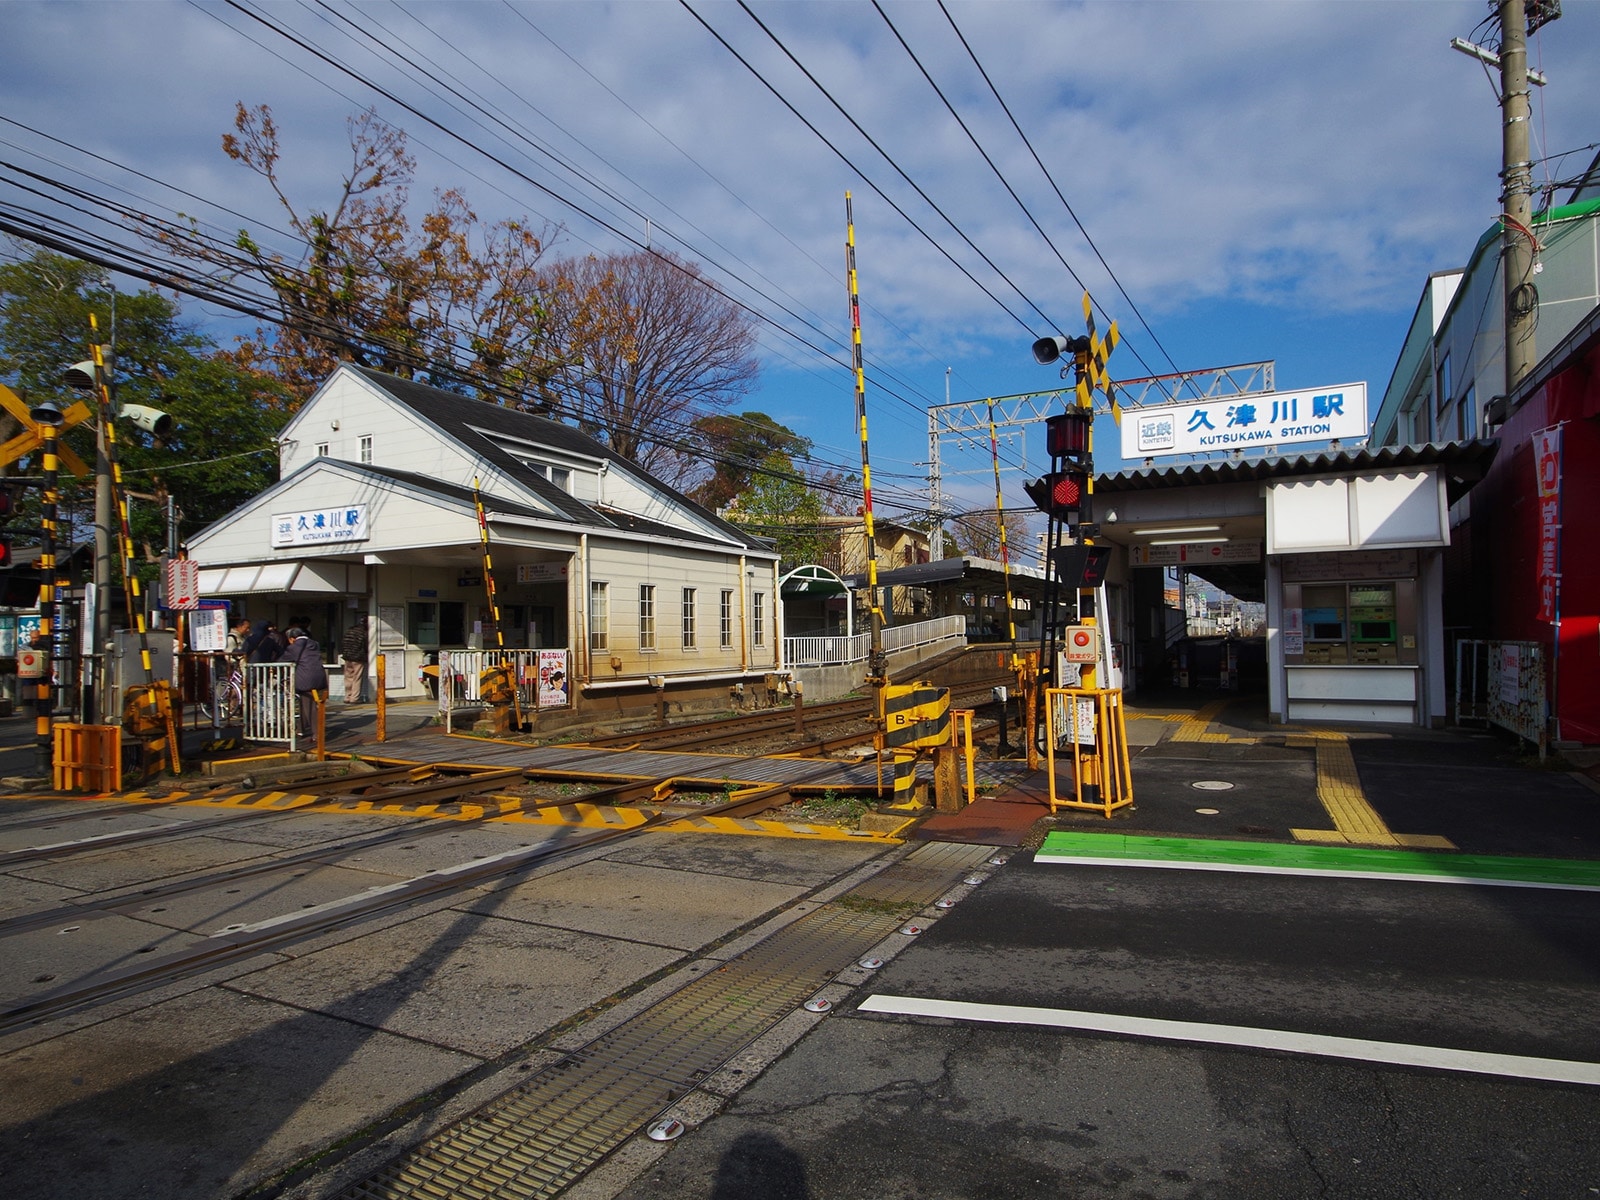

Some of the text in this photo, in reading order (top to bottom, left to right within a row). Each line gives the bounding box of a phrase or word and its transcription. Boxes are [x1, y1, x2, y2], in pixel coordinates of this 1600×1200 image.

[1187, 393, 1345, 432] 久津川駅
[1142, 435, 1172, 445] KINTETSU
[1199, 423, 1331, 446] KUTSUKAWA STATION
[297, 509, 360, 531] 久津川駅
[896, 715, 905, 724] B
